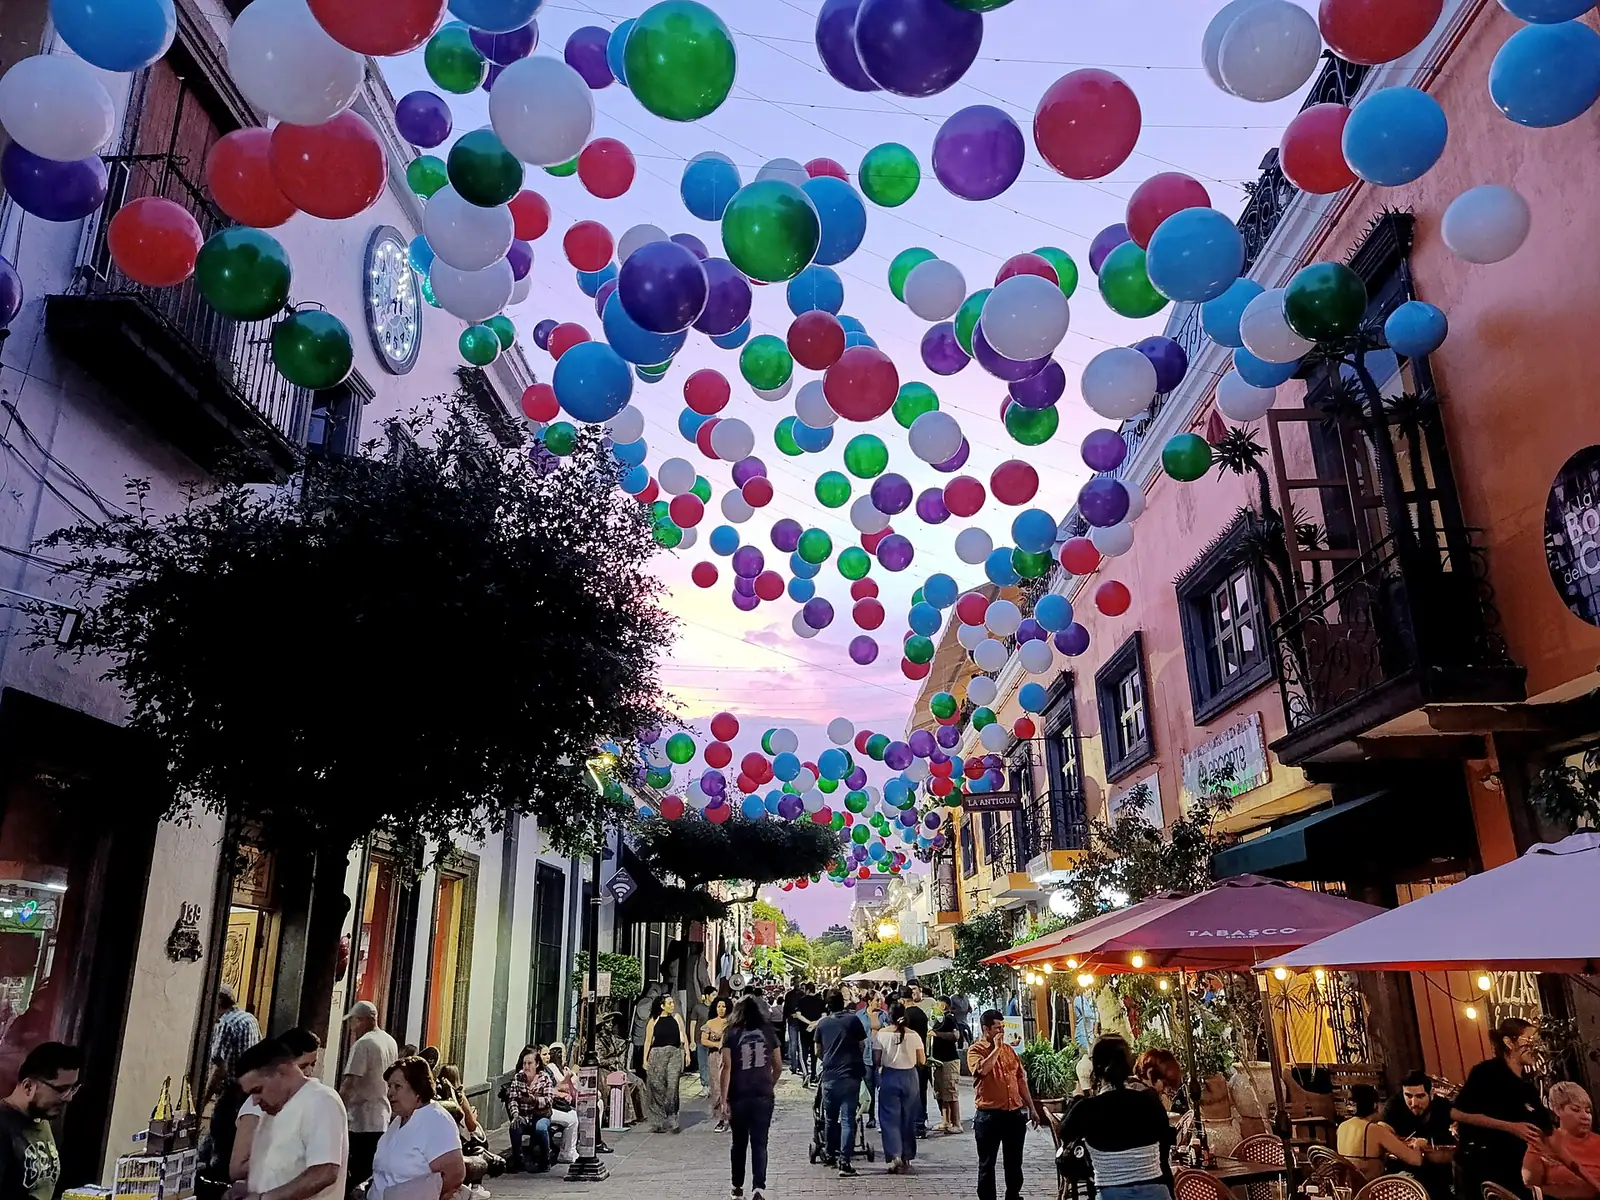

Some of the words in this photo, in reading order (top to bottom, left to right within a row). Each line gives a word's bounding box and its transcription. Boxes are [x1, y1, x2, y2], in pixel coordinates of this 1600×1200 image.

[1576, 492, 1593, 510] La
[1565, 503, 1600, 546] BO
[1563, 563, 1582, 585] del
[967, 799, 979, 807] LA
[979, 797, 1016, 807] ANTIGUA
[180, 901, 203, 924] 139
[1187, 927, 1298, 937] TABASCO
[1486, 970, 1538, 1005] PIZZAS
[740, 1041, 768, 1070] 11
